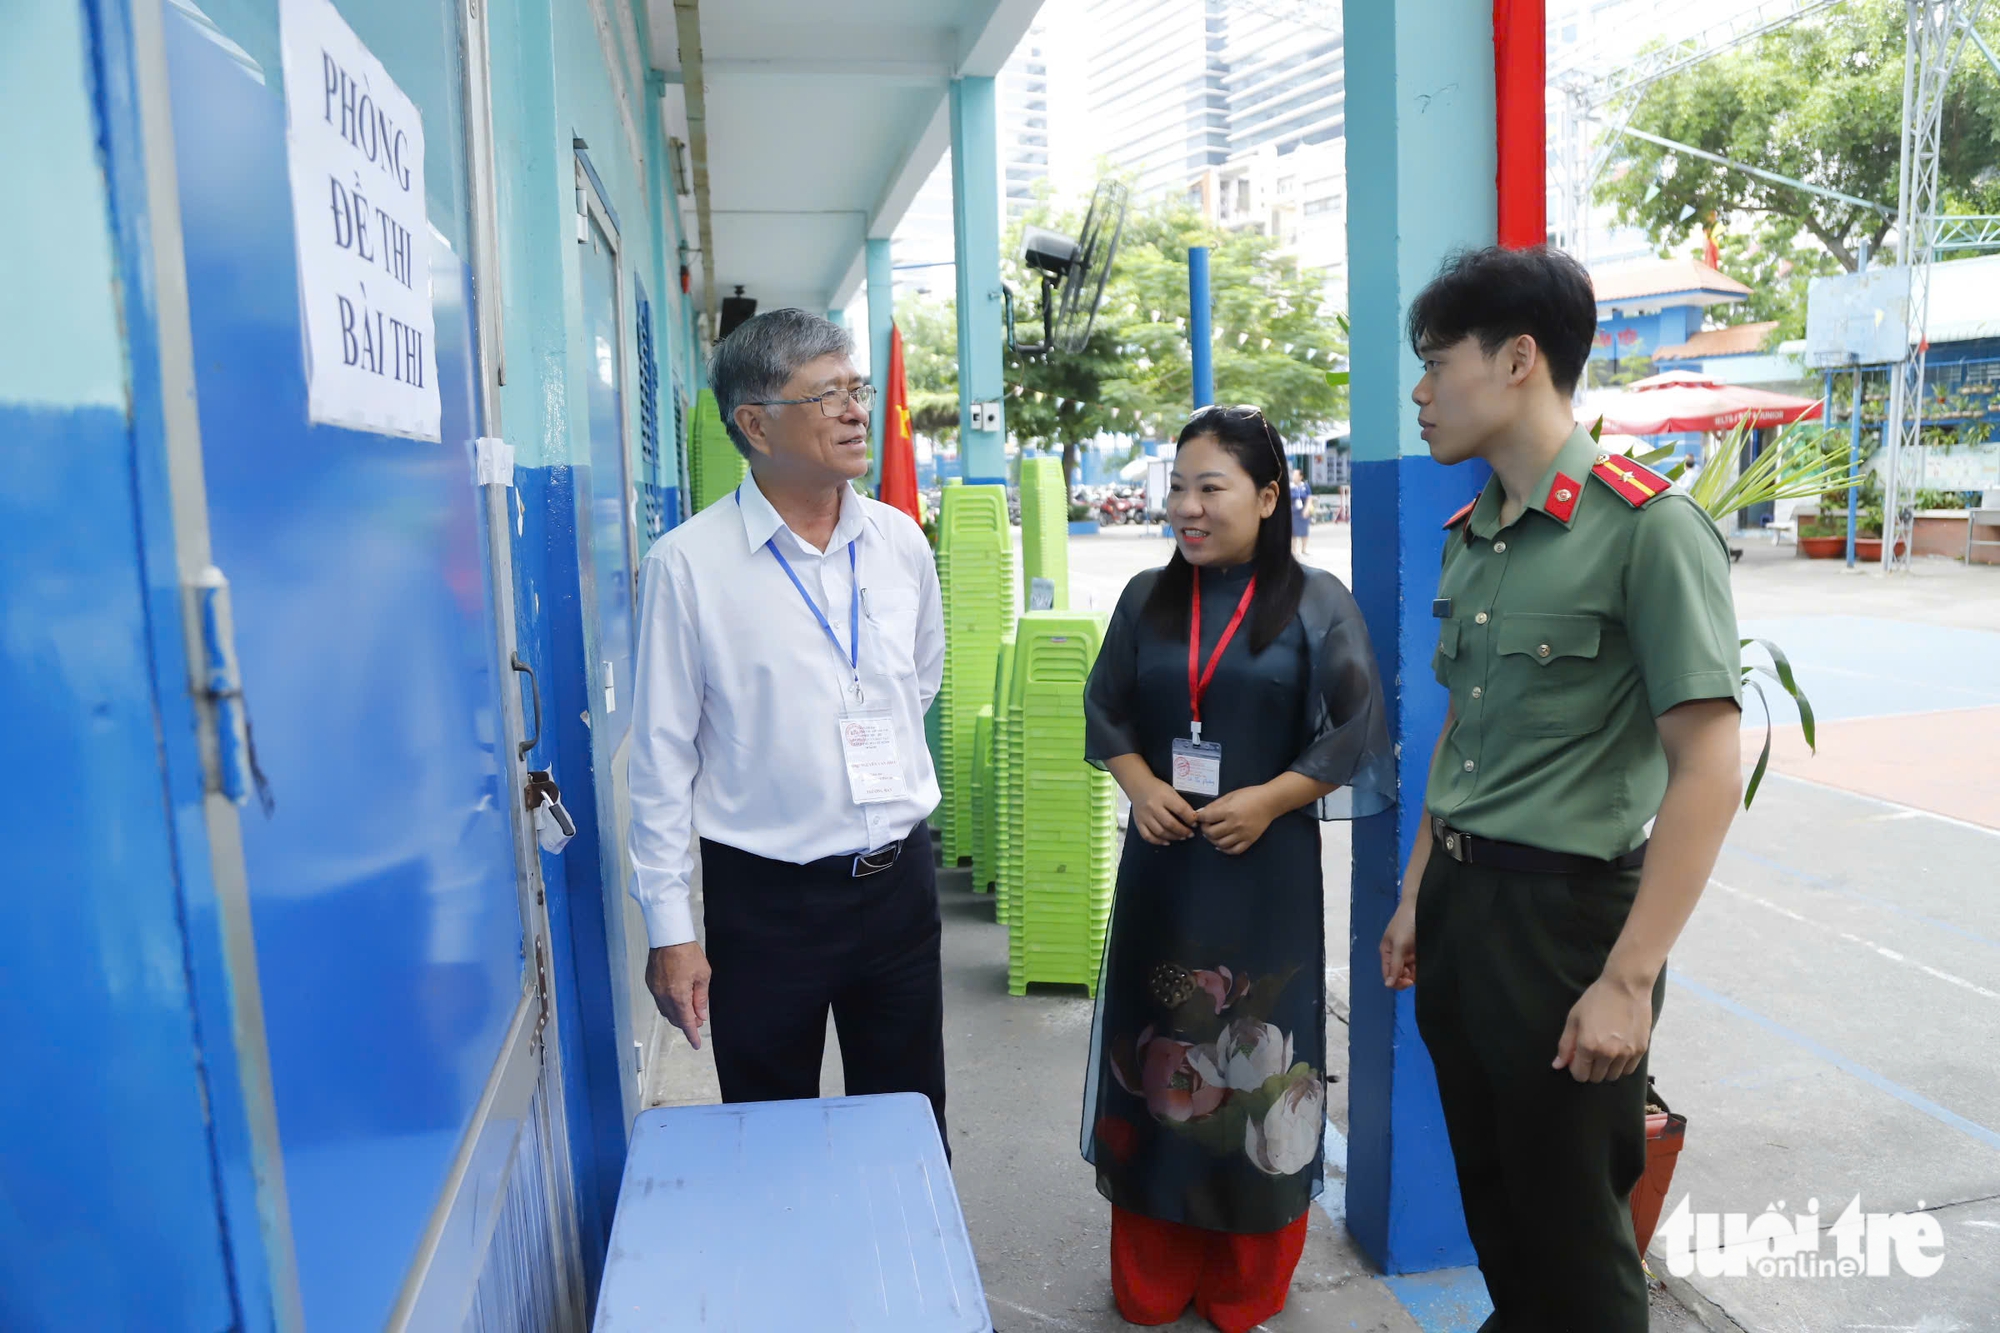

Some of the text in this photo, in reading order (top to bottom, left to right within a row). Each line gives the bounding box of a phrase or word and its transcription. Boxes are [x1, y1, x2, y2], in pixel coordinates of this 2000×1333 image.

[322, 48, 411, 192] PHÒNG
[329, 171, 413, 291] ĐỀ THI
[335, 280, 425, 390] BÀI THI
